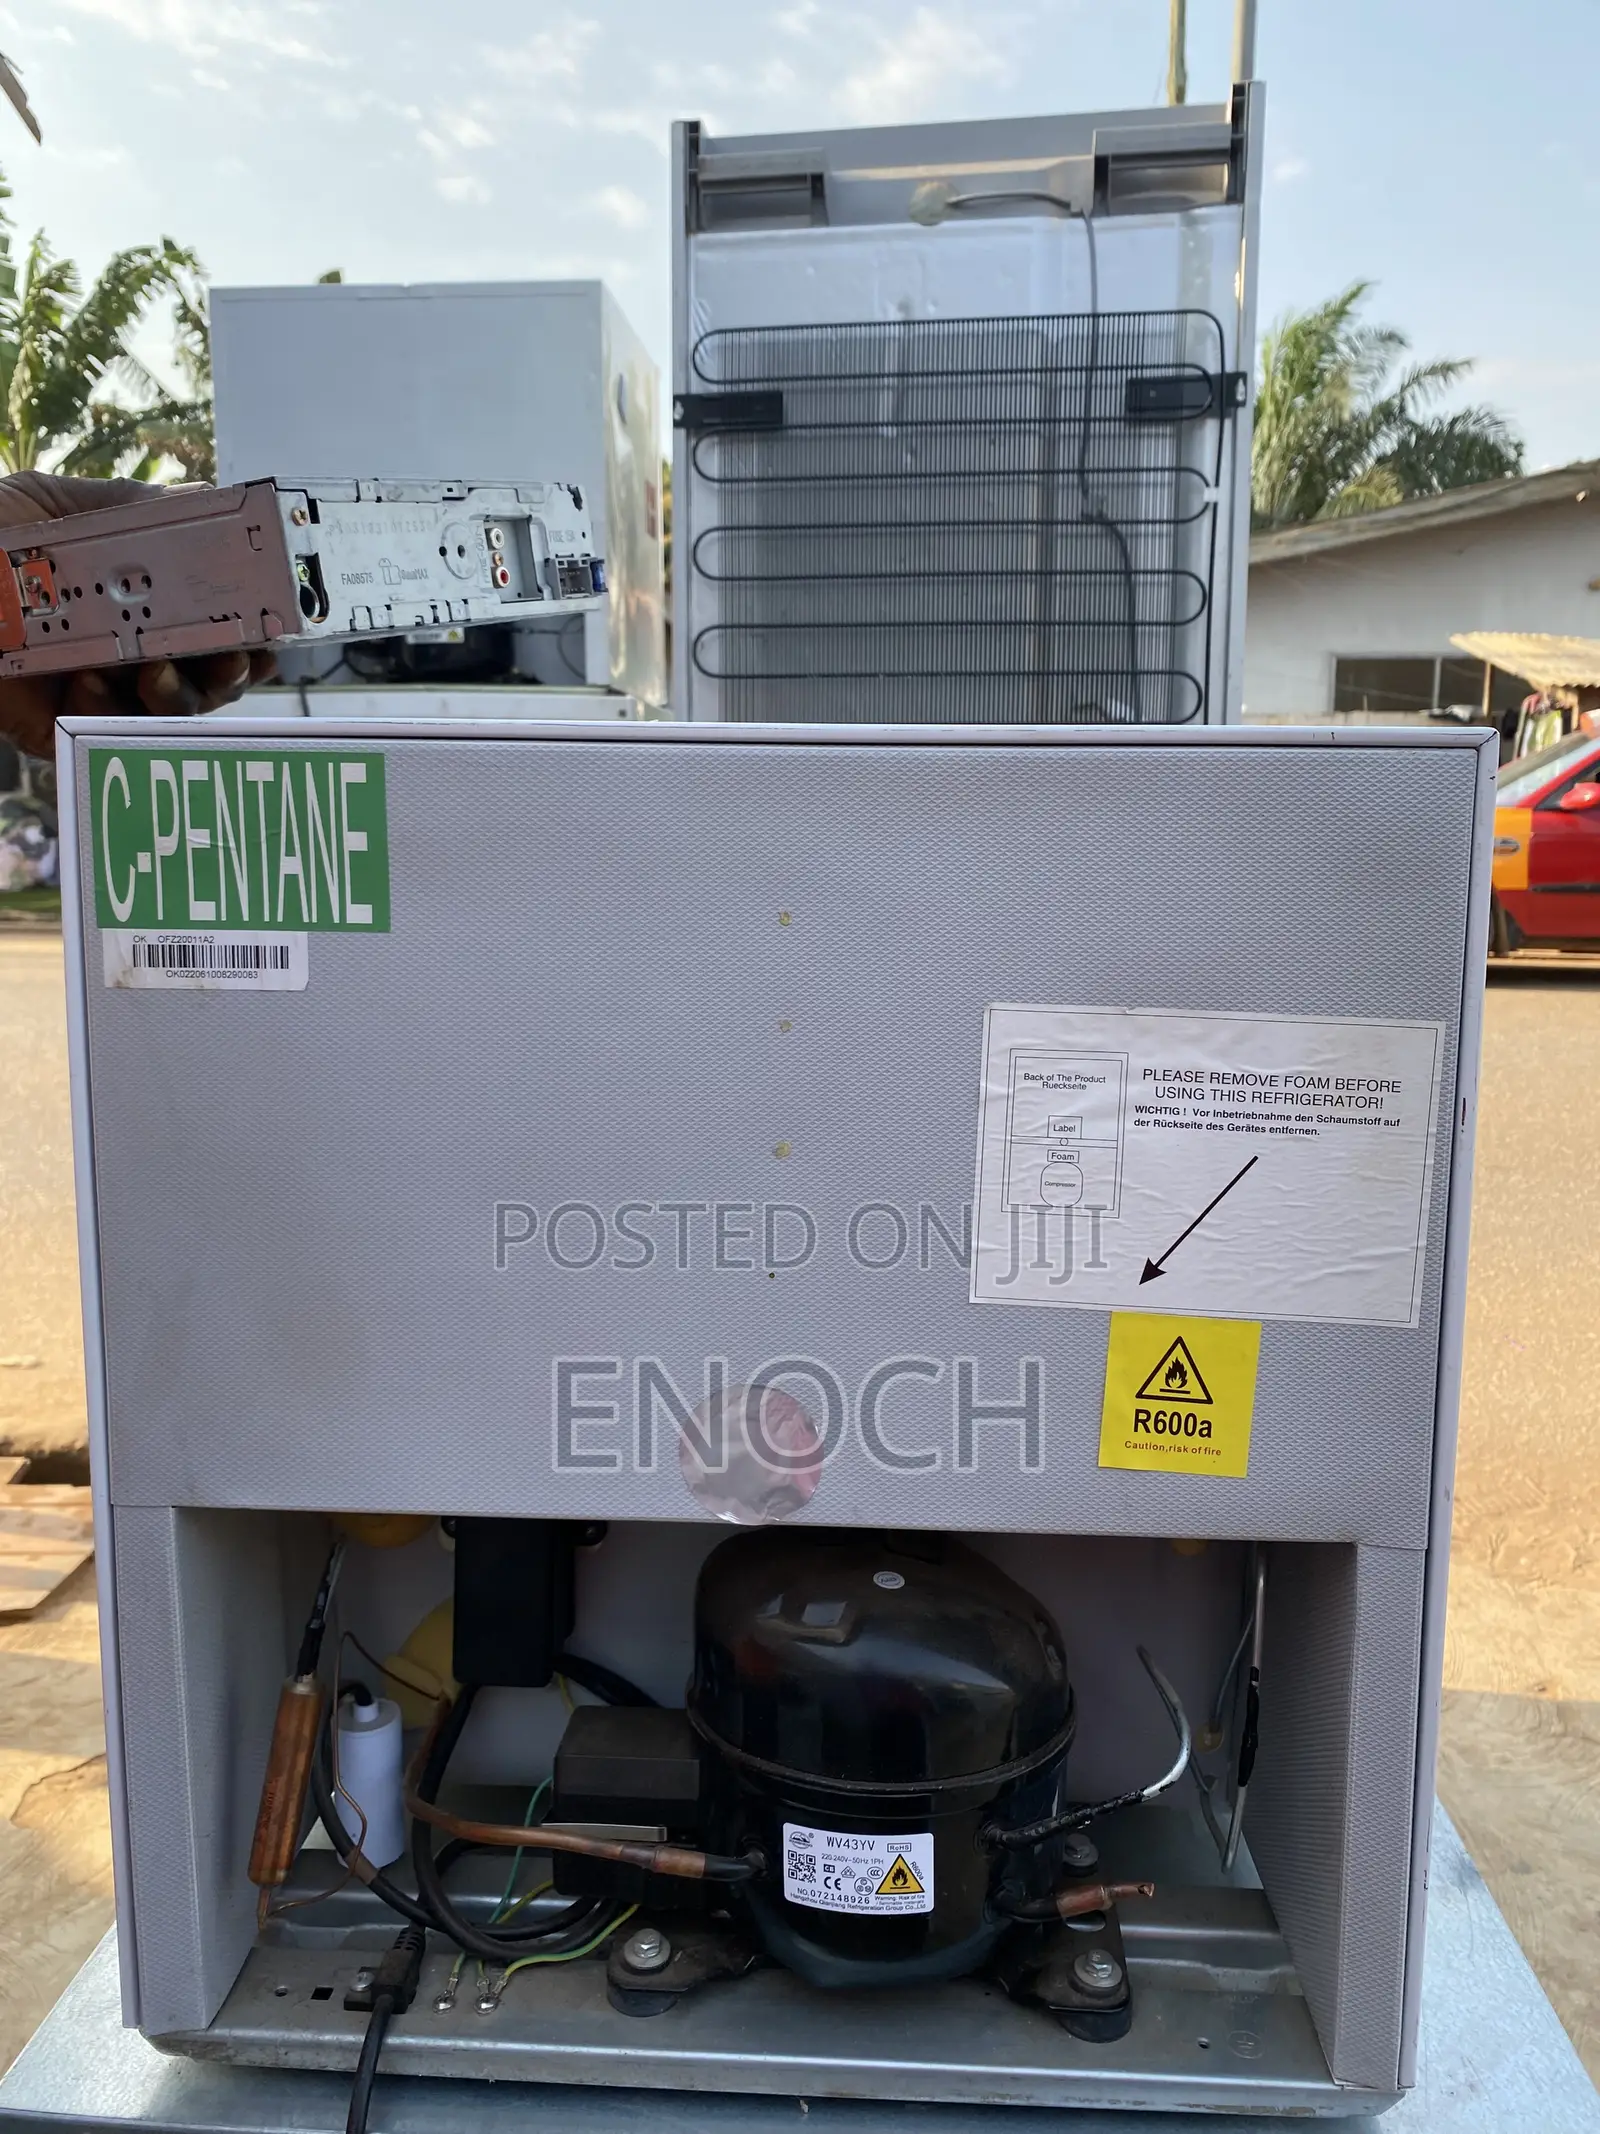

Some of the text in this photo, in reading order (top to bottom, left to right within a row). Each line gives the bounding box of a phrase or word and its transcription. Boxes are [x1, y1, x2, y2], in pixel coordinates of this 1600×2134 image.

[102, 756, 373, 924] C-PENTANE
[133, 935, 147, 943] OK
[1024, 1073, 1044, 1081] Back
[1075, 1075, 1106, 1083] Product
[1143, 1068, 1402, 1093] PLEASE REMOVE FOAM BEFORE
[1042, 1082, 1087, 1090] Rueckseite
[1155, 1086, 1384, 1109] USING THIS REFRIGERATOR!
[1134, 1105, 1180, 1116] WICHTIG
[1192, 1108, 1210, 1117] Vor
[1213, 1109, 1292, 1122] Inbetriebnahme
[1294, 1113, 1313, 1122] den
[1316, 1114, 1381, 1126] Schaumstoff
[1383, 1118, 1401, 1127] auf
[1053, 1124, 1076, 1133] Label
[1133, 1118, 1320, 1136] der Rückseite des Gerätes entfernen.
[1051, 1152, 1075, 1161] Foam
[1044, 1180, 1077, 1188] Compressor
[1133, 1408, 1213, 1438] R600a
[1191, 1446, 1202, 1455] of
[1203, 1446, 1222, 1456] fire
[826, 1836, 875, 1851] WV43YV
